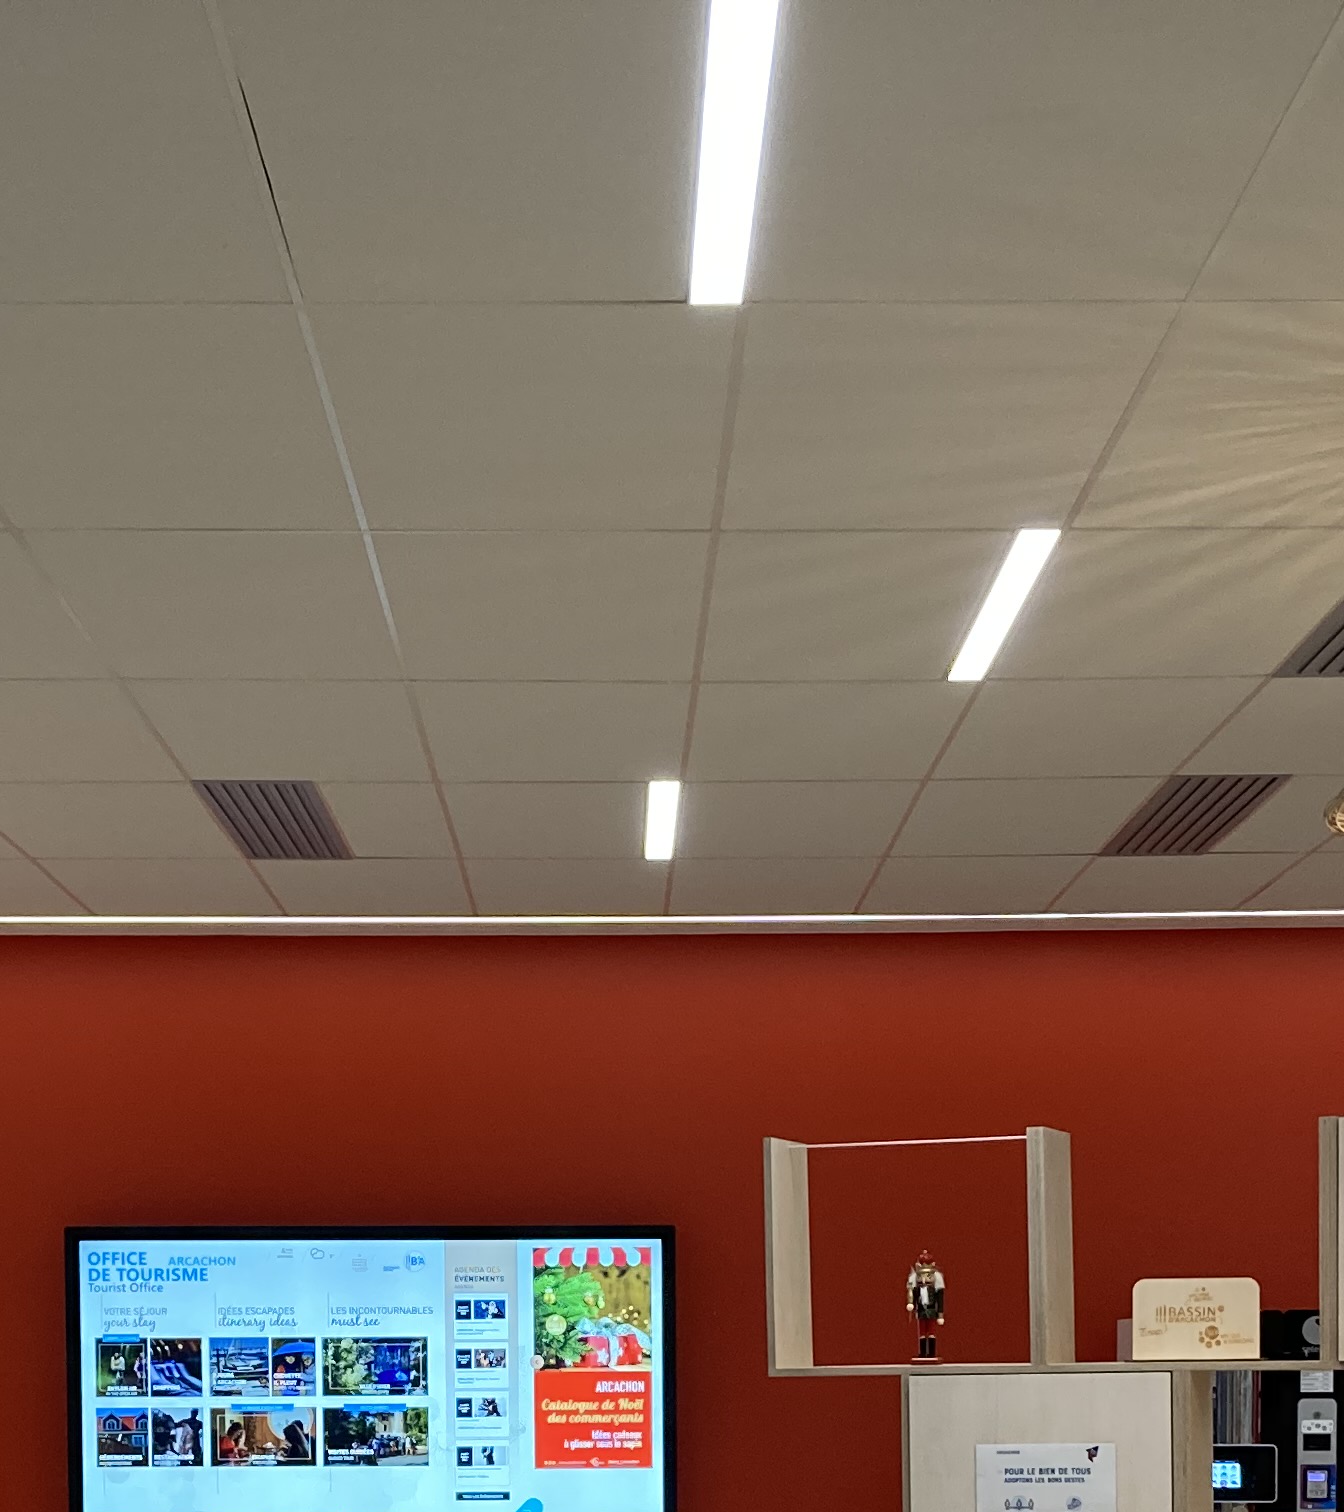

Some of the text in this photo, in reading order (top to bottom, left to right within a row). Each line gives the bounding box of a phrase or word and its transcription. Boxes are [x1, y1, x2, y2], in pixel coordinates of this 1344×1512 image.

[87, 1251, 236, 1266] OFFICE ARCACHON
[88, 1267, 209, 1282] DE TOURISME
[88, 1282, 164, 1293] Tourist Office
[104, 1305, 168, 1316] VOTRE SÉJOUR
[217, 1305, 295, 1315] IDÉES ESCAPADES
[330, 1307, 434, 1315] LES INCONTOURNABLES
[1168, 1306, 1216, 1317] BASSIN
[103, 1315, 156, 1332] your stay
[218, 1314, 299, 1332] itinerary ideas
[330, 1314, 380, 1327] must see
[595, 1380, 645, 1393] ARCACHON
[541, 1398, 644, 1413] Catalogue de Noël
[547, 1412, 644, 1426] des commerçants
[1004, 1467, 1091, 1476] POUR LE BIEN DE TOUS
